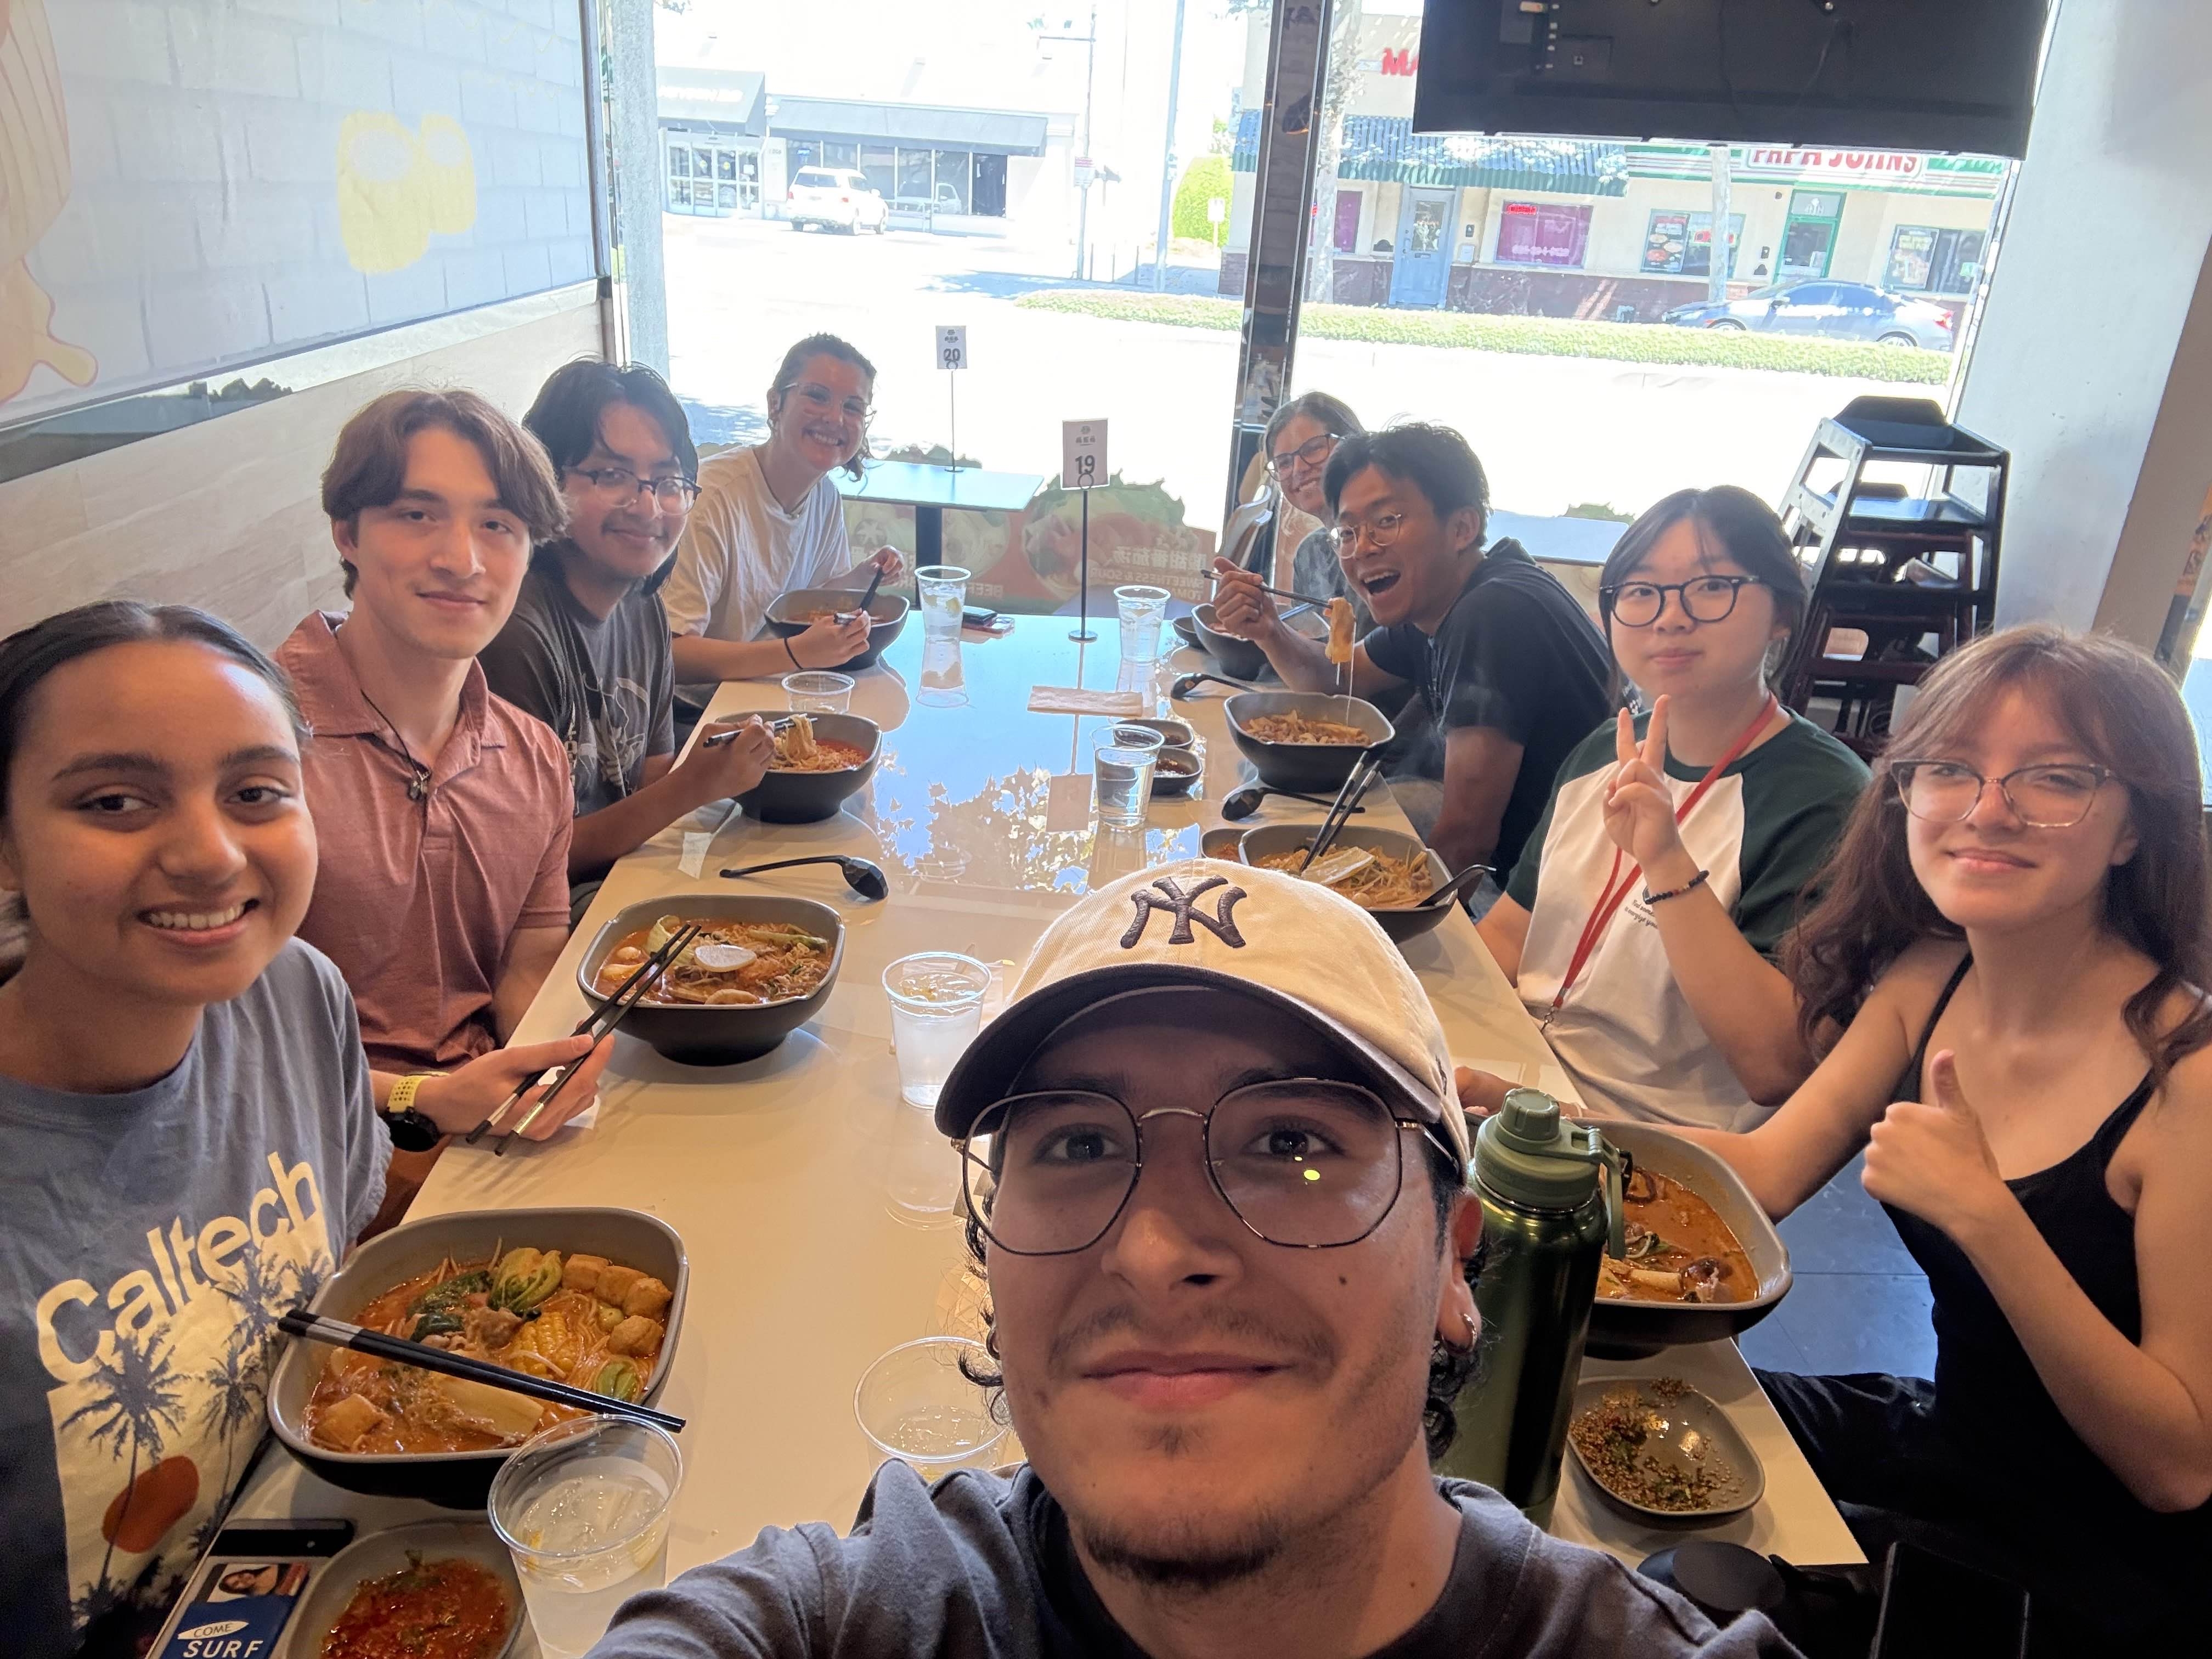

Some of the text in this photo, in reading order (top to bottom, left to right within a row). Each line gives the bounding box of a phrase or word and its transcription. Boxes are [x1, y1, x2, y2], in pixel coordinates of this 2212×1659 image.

[944, 348, 961, 361] 20
[1075, 455, 1096, 474] 19
[1120, 875, 1247, 949] NY
[36, 1151, 328, 1382] Caltech
[193, 1622, 234, 1638] COME
[183, 1640, 264, 1658] SURF
